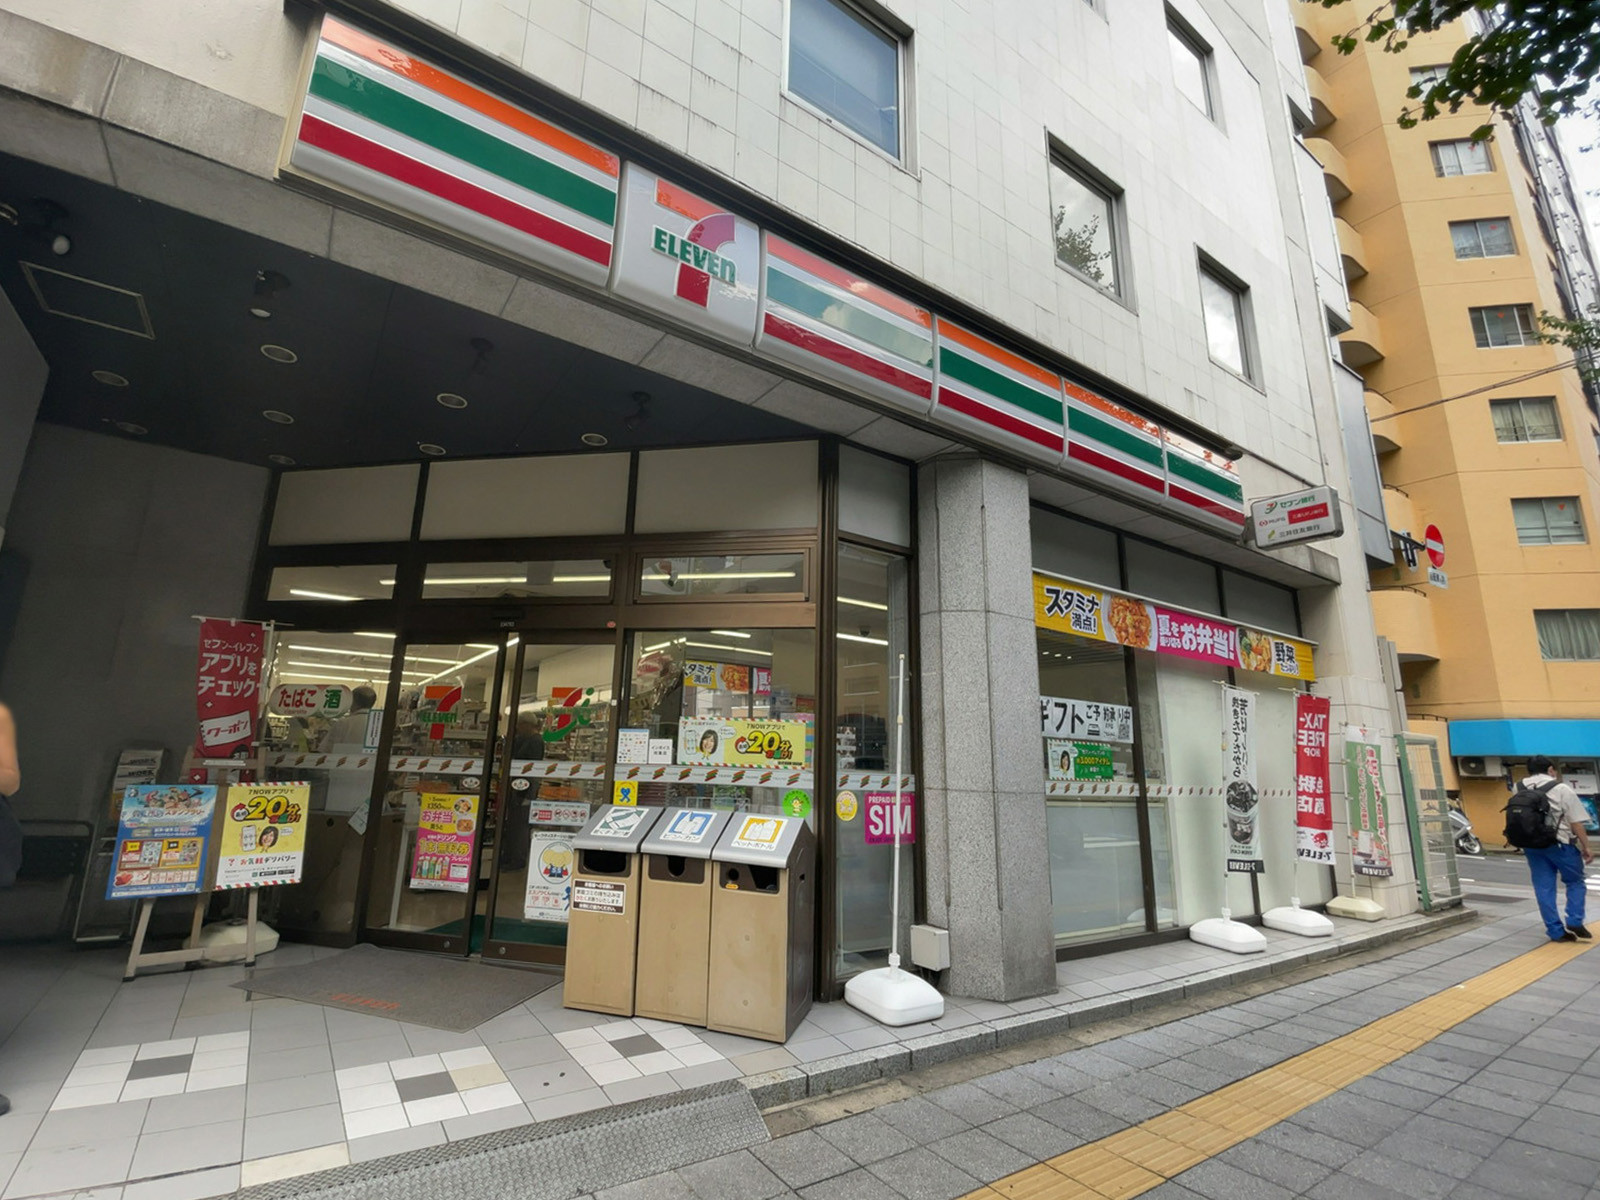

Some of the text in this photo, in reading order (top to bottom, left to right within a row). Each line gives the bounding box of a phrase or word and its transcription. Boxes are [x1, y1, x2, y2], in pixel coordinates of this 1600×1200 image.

[1280, 495, 1315, 508] セブン銀行
[1280, 525, 1320, 537] 三井住友銀行
[1045, 587, 1099, 615] スタミナ
[1180, 623, 1235, 660] お弁当!
[1274, 641, 1295, 664] 野菜
[200, 652, 257, 676] アプリを
[197, 675, 255, 698] チェック
[278, 688, 343, 708] たばこ 酒
[206, 720, 249, 738] クーポン
[869, 805, 912, 836] SIM
[734, 840, 775, 850] ペットボトル
